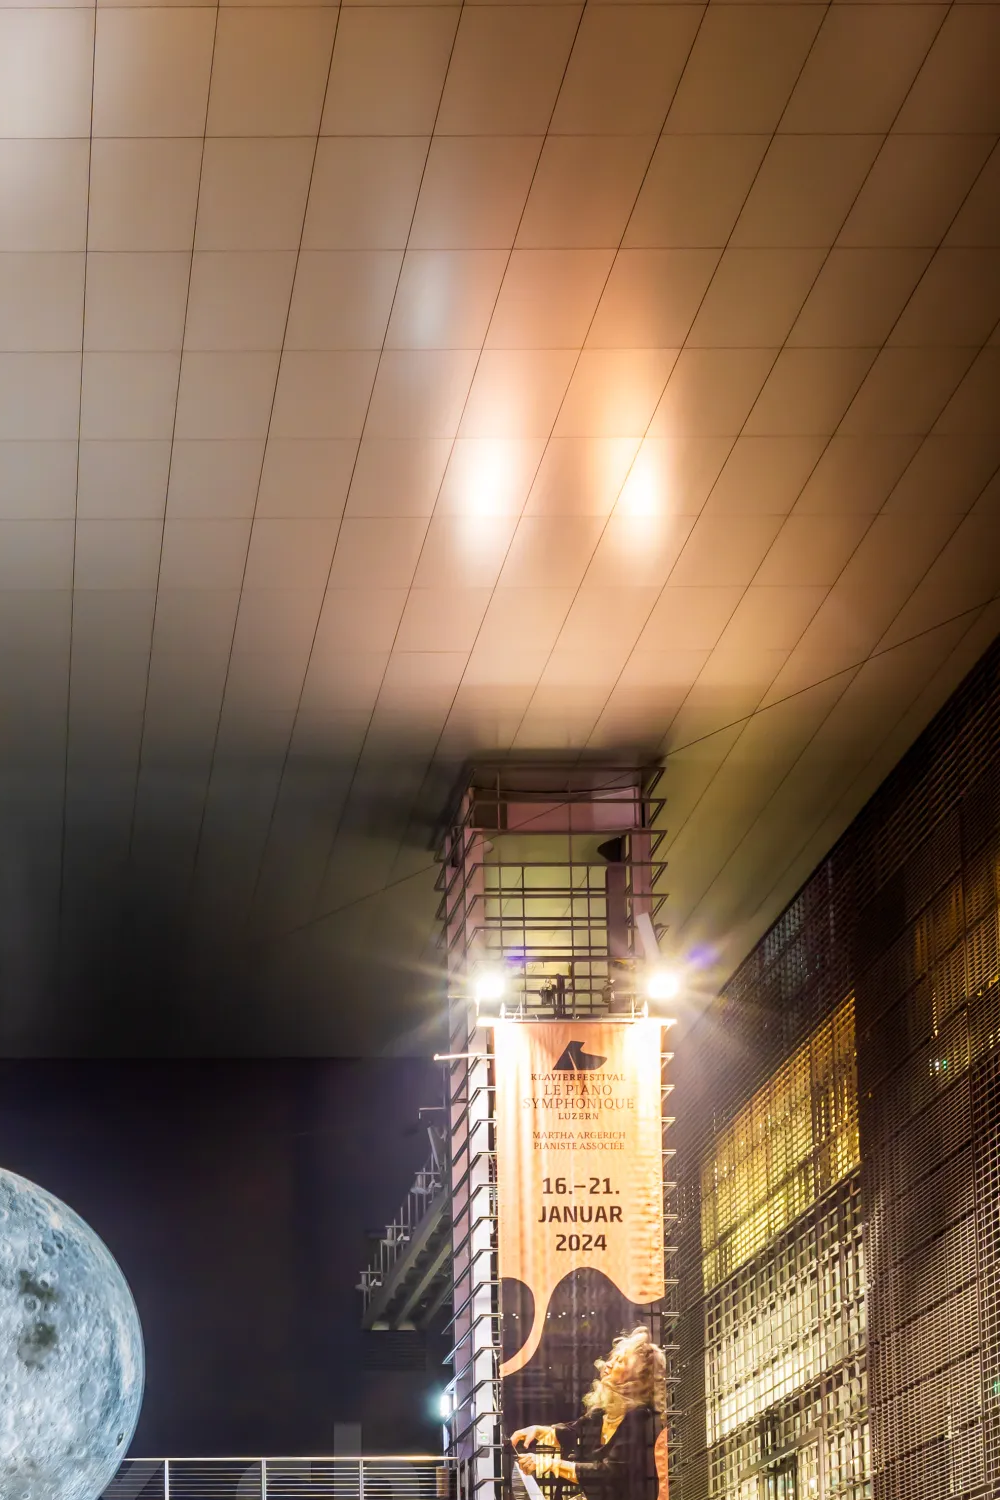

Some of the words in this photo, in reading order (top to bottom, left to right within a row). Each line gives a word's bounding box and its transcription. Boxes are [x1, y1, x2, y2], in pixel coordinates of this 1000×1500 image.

[531, 1073, 626, 1081] KLAVIERFESTIVAL
[544, 1084, 562, 1096] LE
[565, 1084, 613, 1096] PIANO
[522, 1098, 635, 1111] SYMPHONIQUE
[532, 1131, 574, 1140] MARTHA
[577, 1131, 626, 1140] ARGERICH
[533, 1142, 578, 1150] PIANISTE
[579, 1140, 625, 1150] ASSOCIÉE
[538, 1205, 623, 1223] JANUAR
[555, 1234, 608, 1252] 2024
